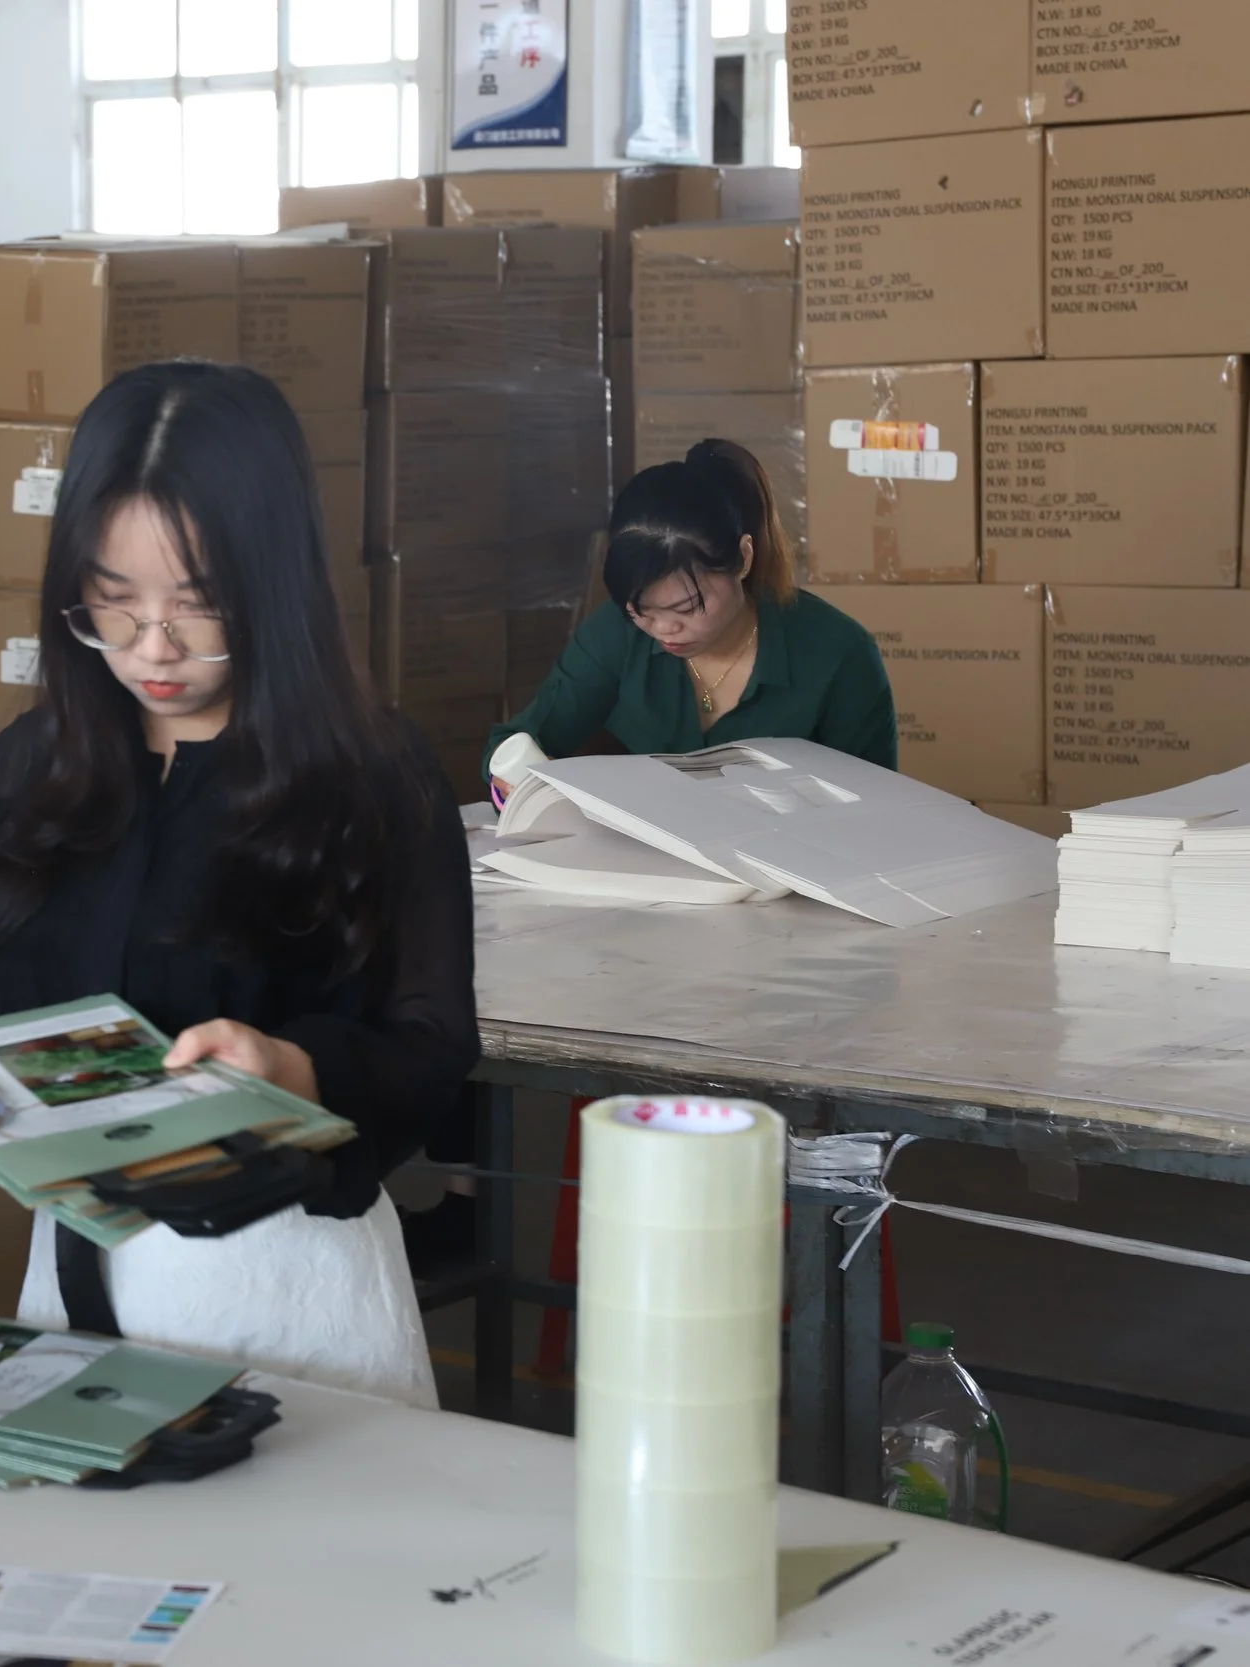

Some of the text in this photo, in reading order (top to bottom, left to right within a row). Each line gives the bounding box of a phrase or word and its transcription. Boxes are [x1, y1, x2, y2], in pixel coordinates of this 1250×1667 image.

[820, 0, 845, 14] 1500
[848, 0, 867, 10] PCS
[1070, 8, 1083, 19] 18
[1086, 6, 1102, 17] KG
[820, 19, 833, 30] 19
[835, 18, 848, 29] KG
[1037, 28, 1060, 39] CTN
[820, 37, 832, 47] 18
[835, 35, 849, 46] KG
[1037, 46, 1059, 57] BOX
[792, 56, 812, 68] CTN
[1037, 58, 1127, 75] MADE IN CHINA
[793, 73, 813, 85] BOX
[793, 84, 875, 101] MADE IN CHINA
[1052, 174, 1156, 191] HONGJU PRINTING
[805, 189, 900, 207] HONGJU PRINTING
[1086, 193, 1143, 207] MONSTAN
[1147, 191, 1177, 204] ORAL
[1180, 187, 1250, 202] SUSPENSION
[837, 207, 891, 220] MONSTAN
[893, 205, 920, 217] ORAL
[924, 200, 991, 215] SUSPENSION
[994, 197, 1022, 209] PACK
[1083, 212, 1109, 224] 1500
[1112, 211, 1133, 223] PCS
[835, 226, 859, 238] 1500
[862, 225, 881, 236] PCS
[1083, 231, 1095, 242] 19
[1098, 230, 1112, 241] KG
[835, 244, 847, 255] 19
[849, 243, 862, 254] KG
[1083, 249, 1094, 259] 18
[1097, 248, 1112, 259] KG
[834, 260, 846, 271] 18
[849, 259, 862, 270] KG
[1051, 267, 1072, 278] CTN
[806, 278, 826, 290] CTN
[1052, 286, 1072, 296] BOX
[806, 296, 827, 307] BOX
[1051, 300, 1137, 313] MADE IN CHINA
[807, 308, 887, 323] MADE IN CHINA
[987, 407, 1087, 419] HONGJU PRINTING
[1020, 425, 1076, 436] MONSTAN
[1079, 424, 1109, 436] ORAL
[1112, 424, 1183, 435] SUSPENSION
[1186, 423, 1216, 434] PACK
[1017, 442, 1043, 453] 1500
[1046, 442, 1065, 453] PCS
[1017, 459, 1029, 470] 19
[1031, 459, 1045, 469] KG
[1016, 477, 1028, 486] 18
[1031, 477, 1045, 487] KG
[986, 494, 1007, 504] CTN
[987, 511, 1007, 522] BOX
[987, 527, 1071, 538] MADE IN CHINA
[1053, 633, 1156, 646] HONGJU PRINTING
[892, 649, 918, 660] ORAL
[922, 649, 988, 660] SUSPENSION
[991, 650, 1020, 660] PACK
[1087, 651, 1144, 663] MONSTAN
[1147, 652, 1177, 664] ORAL
[1181, 653, 1250, 667] SUSPENSION
[1085, 667, 1111, 679] 1500
[1113, 669, 1134, 680] PCS
[1085, 684, 1097, 694] 19
[1100, 685, 1113, 696] KG
[1085, 702, 1096, 712] 18
[1099, 702, 1113, 713] KG
[1054, 717, 1075, 728] CTN
[1054, 734, 1074, 745] BOX
[1054, 750, 1139, 765] MADE IN CHINA
